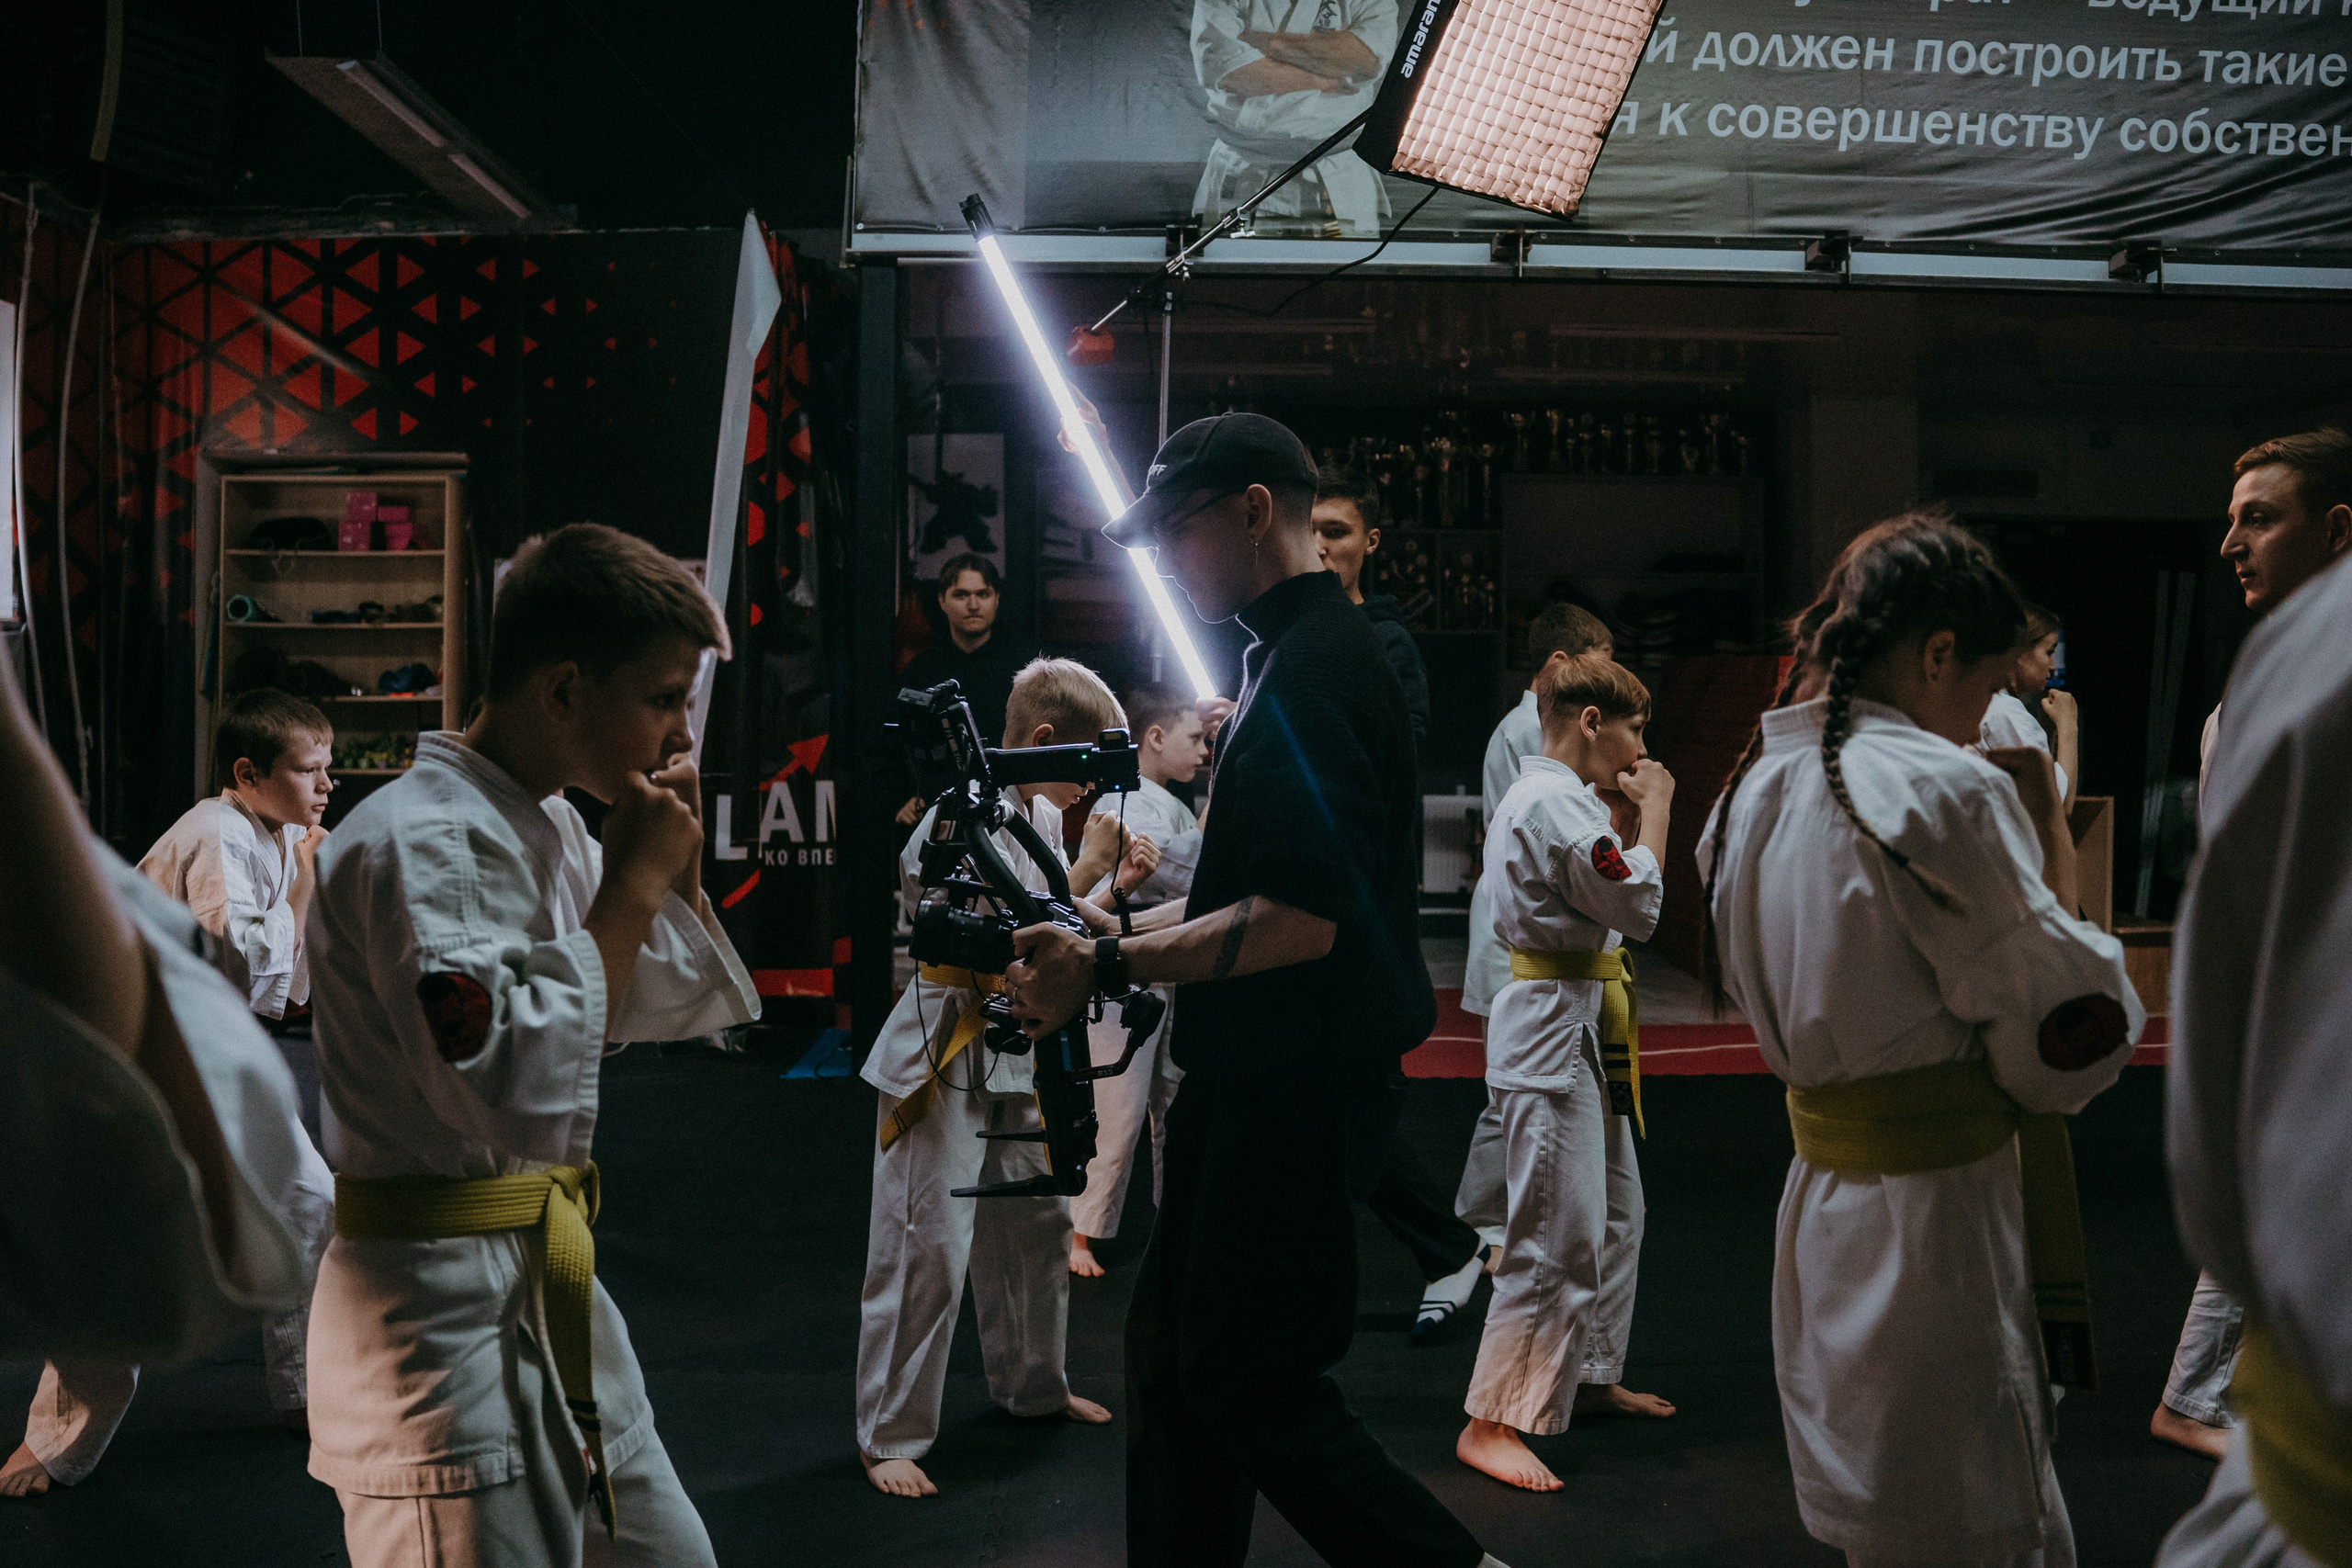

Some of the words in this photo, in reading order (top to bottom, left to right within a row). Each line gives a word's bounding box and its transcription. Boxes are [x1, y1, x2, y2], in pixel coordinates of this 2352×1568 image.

[1400, 0, 1442, 79] amaran
[1691, 30, 1896, 73] должен
[1914, 39, 2182, 87] построить
[2198, 49, 2348, 88] такие
[1657, 101, 1693, 137] к
[1706, 103, 2105, 161] совершенству
